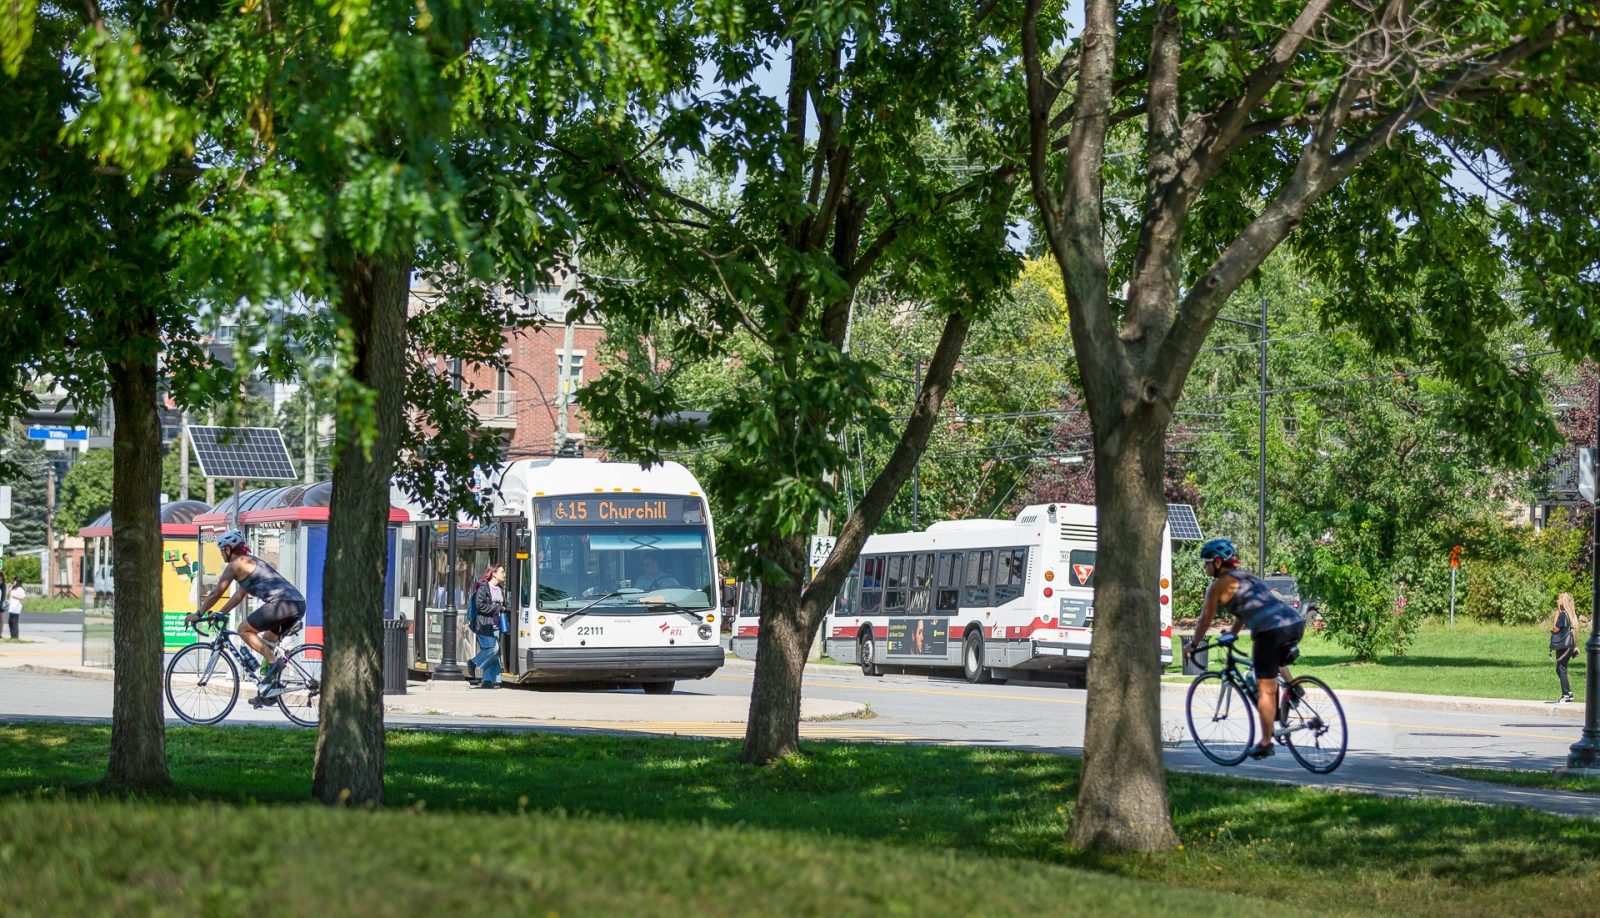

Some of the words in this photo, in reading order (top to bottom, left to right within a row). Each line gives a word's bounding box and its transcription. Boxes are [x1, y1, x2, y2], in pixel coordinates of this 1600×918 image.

[568, 501, 587, 520] 15
[599, 501, 667, 519] Churchill
[577, 626, 604, 636] 22111
